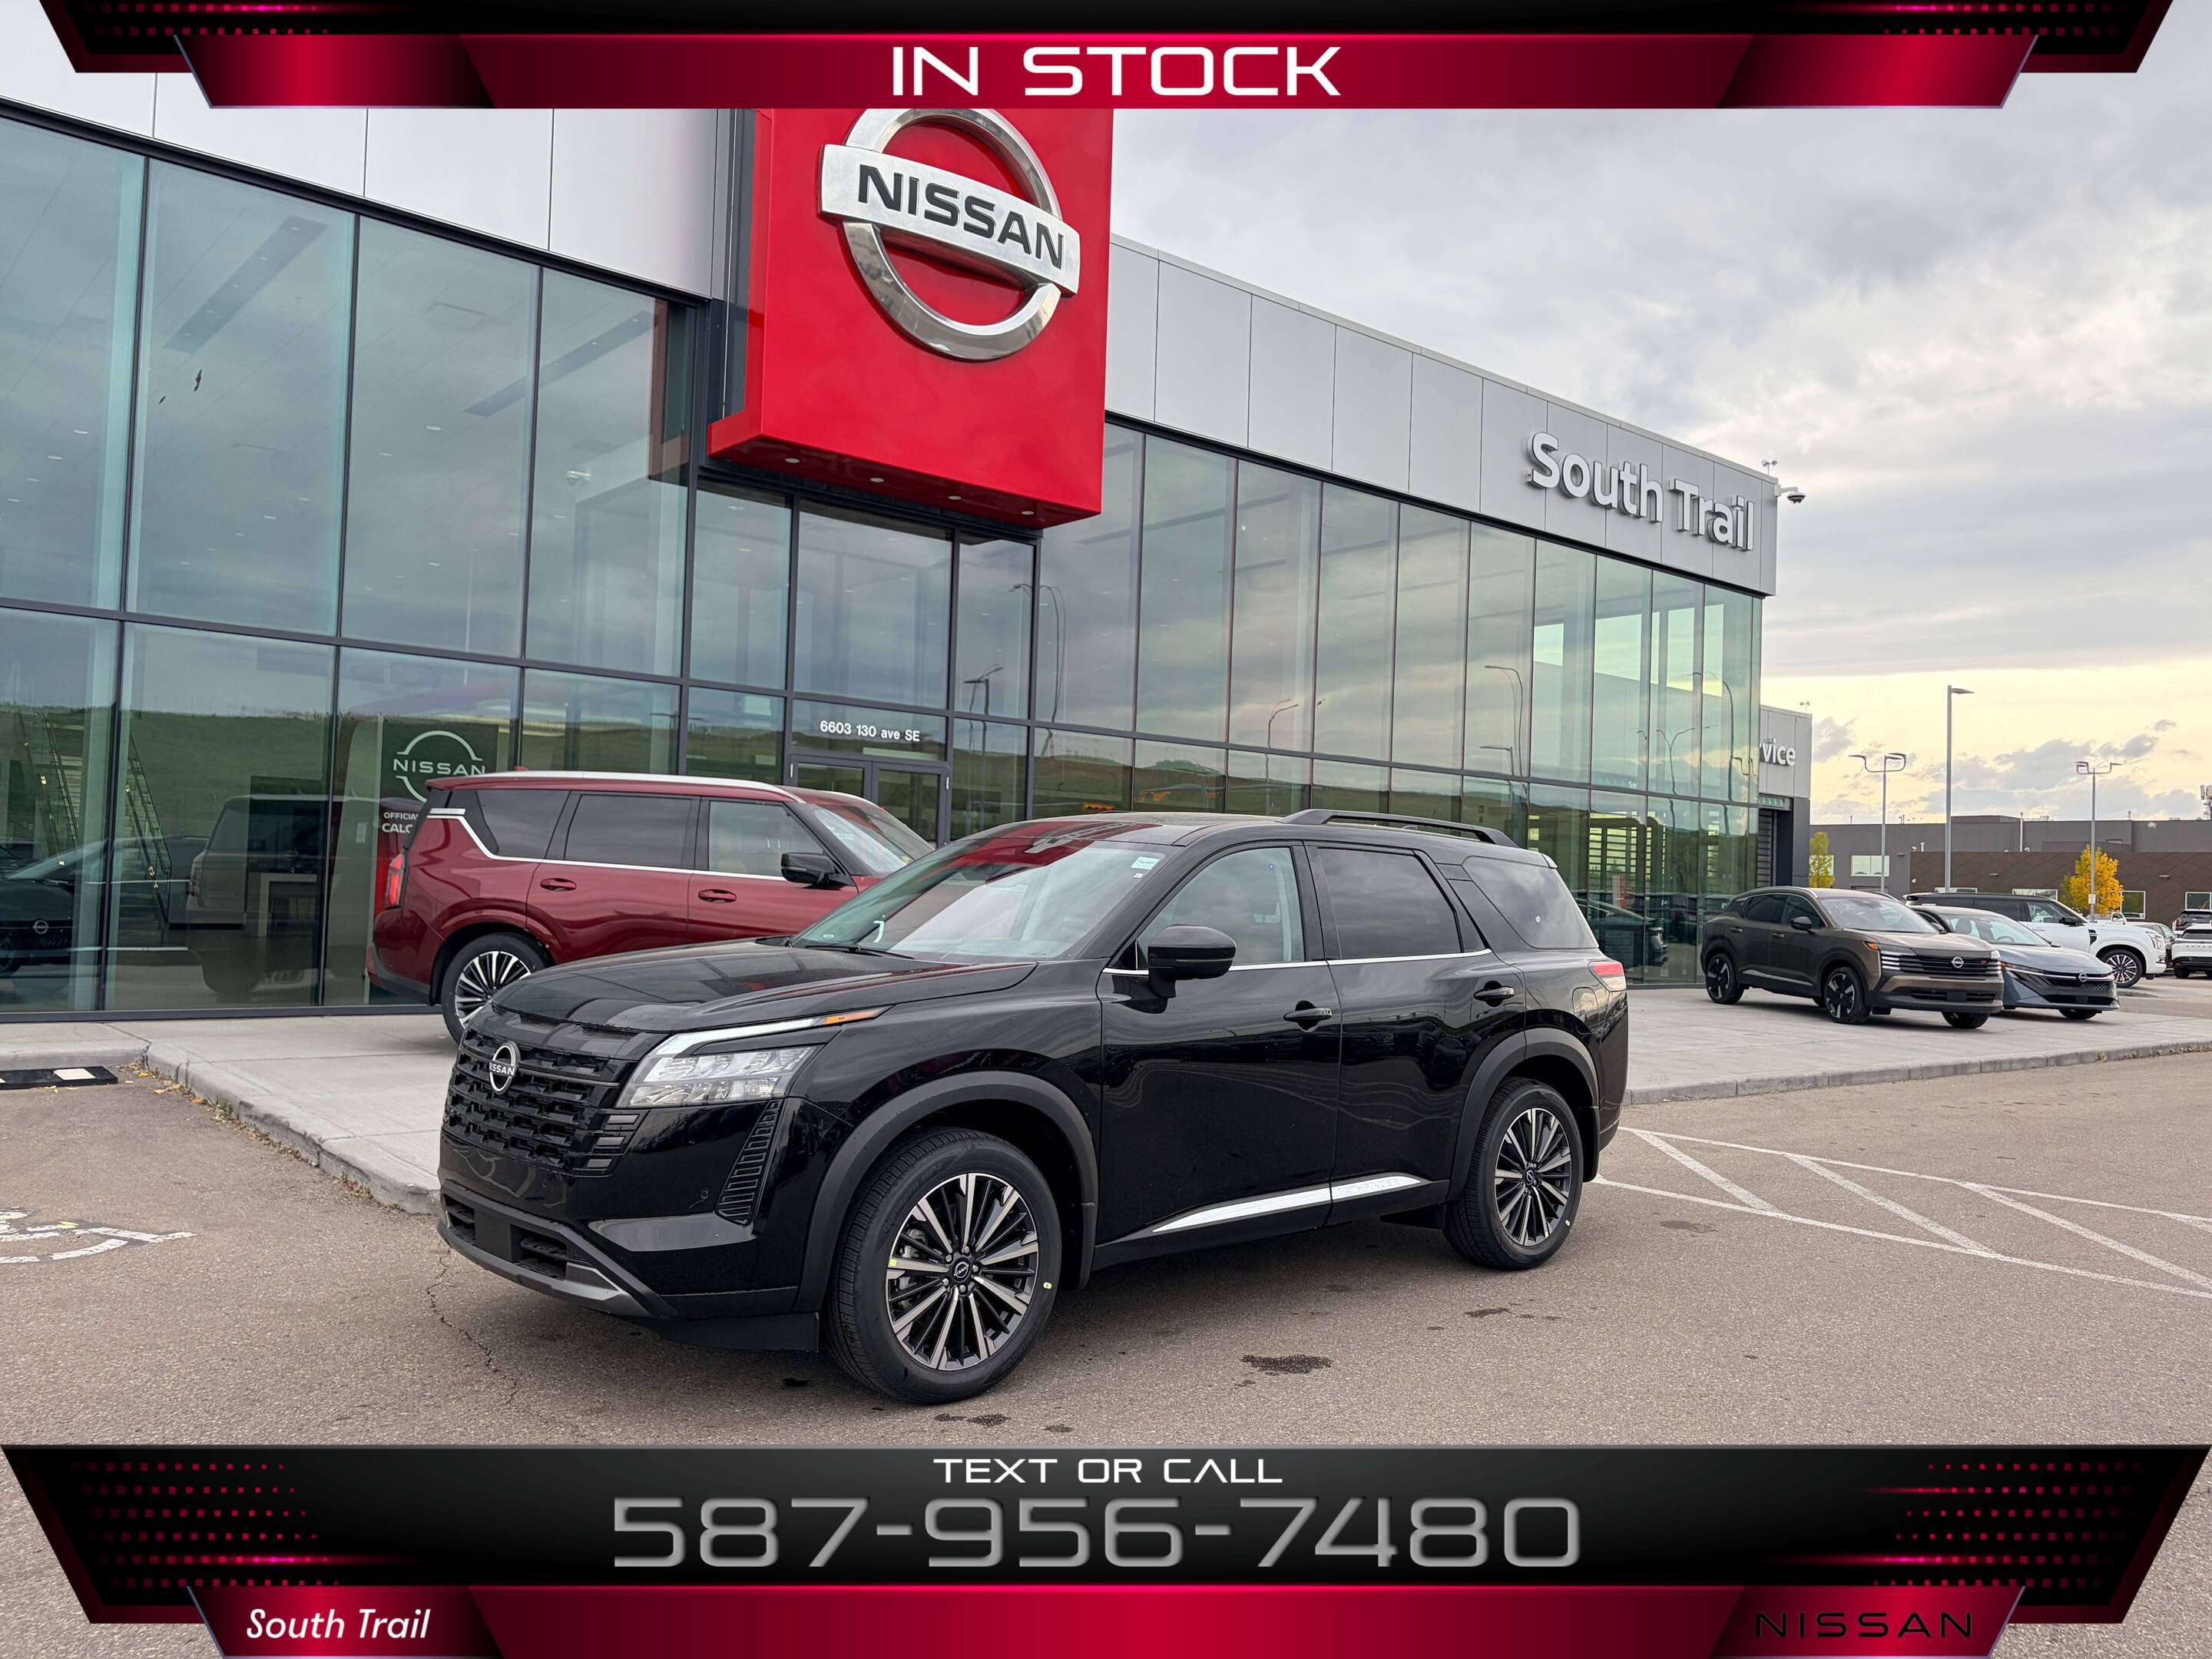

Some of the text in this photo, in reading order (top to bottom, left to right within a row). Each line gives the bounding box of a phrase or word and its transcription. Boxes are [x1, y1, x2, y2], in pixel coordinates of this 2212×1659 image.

[857, 164, 1065, 270] NISSAN
[1525, 431, 1755, 551] South Trail
[820, 720, 920, 742] 6603 130 ave SE
[1759, 737, 1796, 767] vice
[392, 758, 486, 777] NISSAN
